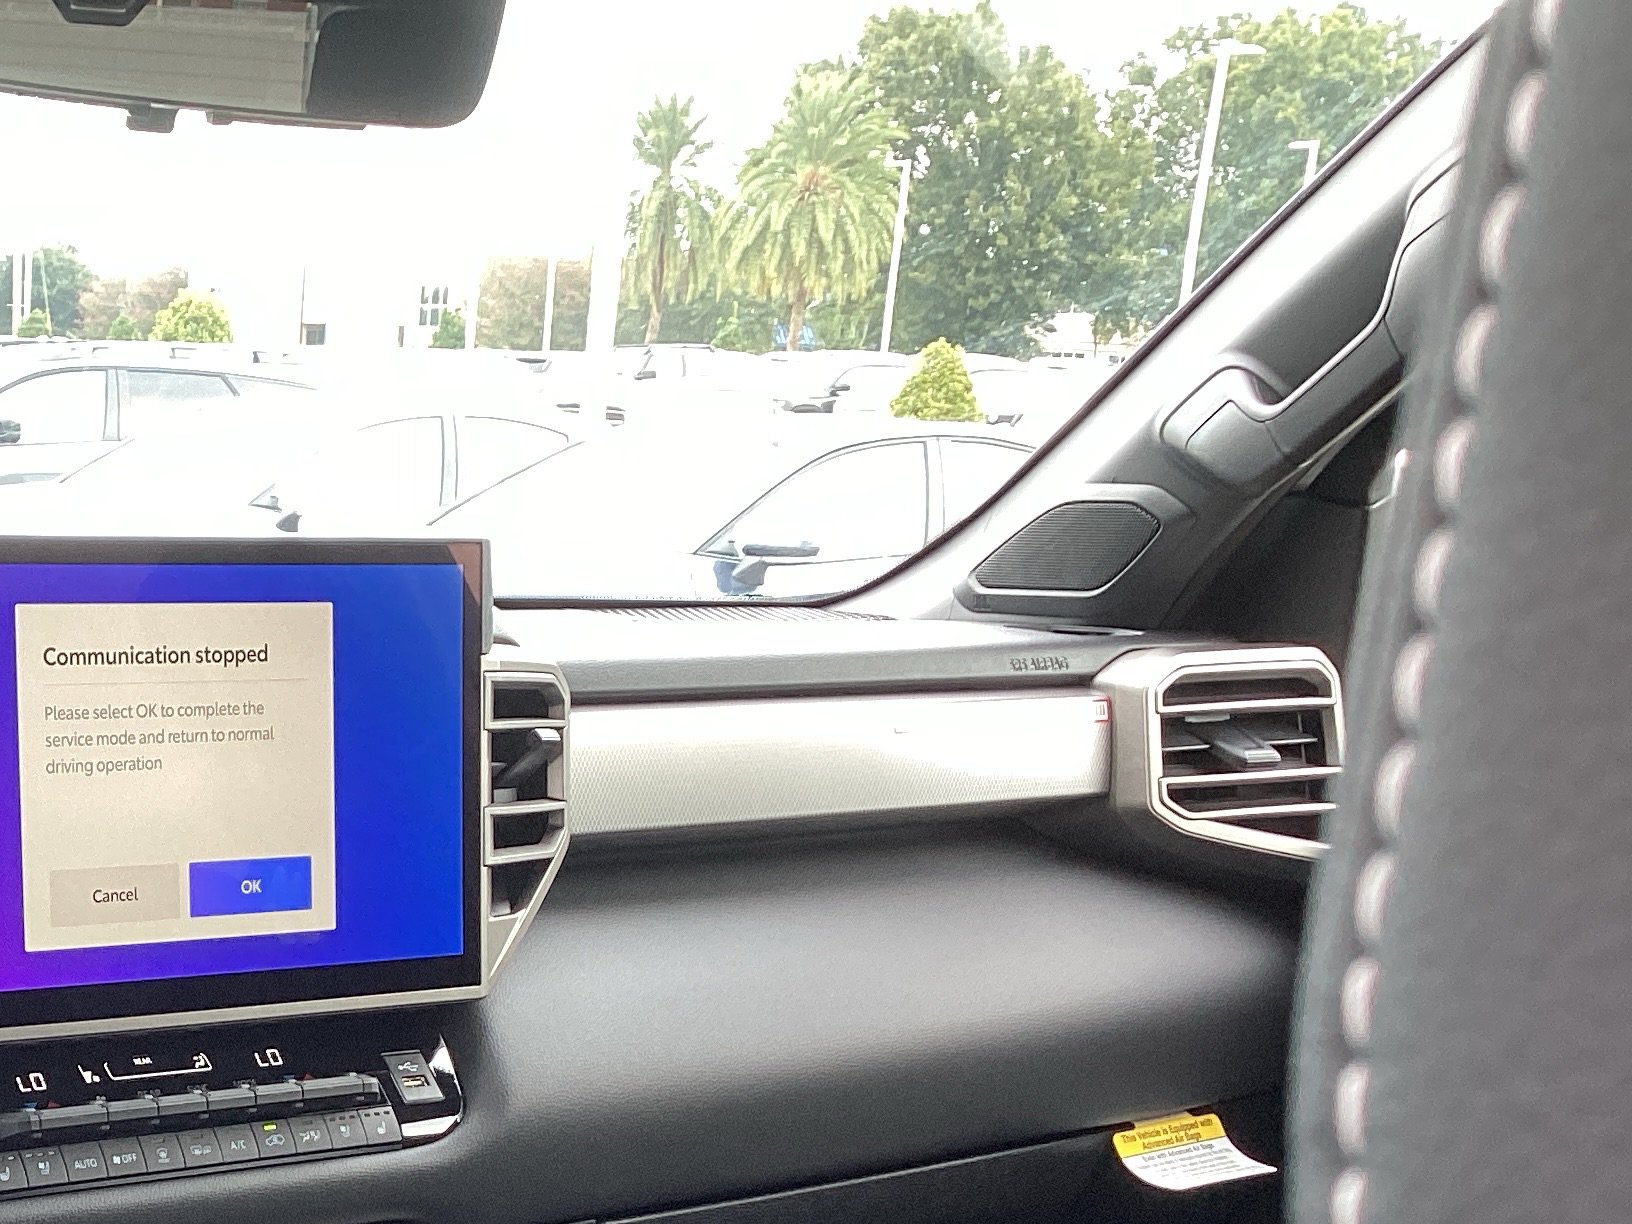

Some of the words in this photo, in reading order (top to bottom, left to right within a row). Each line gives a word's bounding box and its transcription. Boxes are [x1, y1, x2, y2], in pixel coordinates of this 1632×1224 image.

[43, 645, 191, 666] Communication
[195, 643, 269, 668] stopped
[44, 705, 90, 721] Please
[93, 704, 134, 720] select
[136, 703, 158, 718] OK
[161, 703, 175, 718] to
[177, 702, 241, 720] complete
[242, 701, 265, 716] the
[45, 731, 94, 748] service
[96, 730, 136, 746] mode
[139, 729, 165, 745] and
[168, 730, 209, 744] return
[211, 728, 225, 743] to
[227, 726, 275, 742] normal
[46, 758, 94, 777] driving
[96, 756, 163, 776] operation
[92, 887, 139, 904] Cancel
[241, 880, 262, 894] OK
[230, 1140, 247, 1151] A/C
[74, 1158, 98, 1170] AUTO
[121, 1153, 137, 1163] OFF
